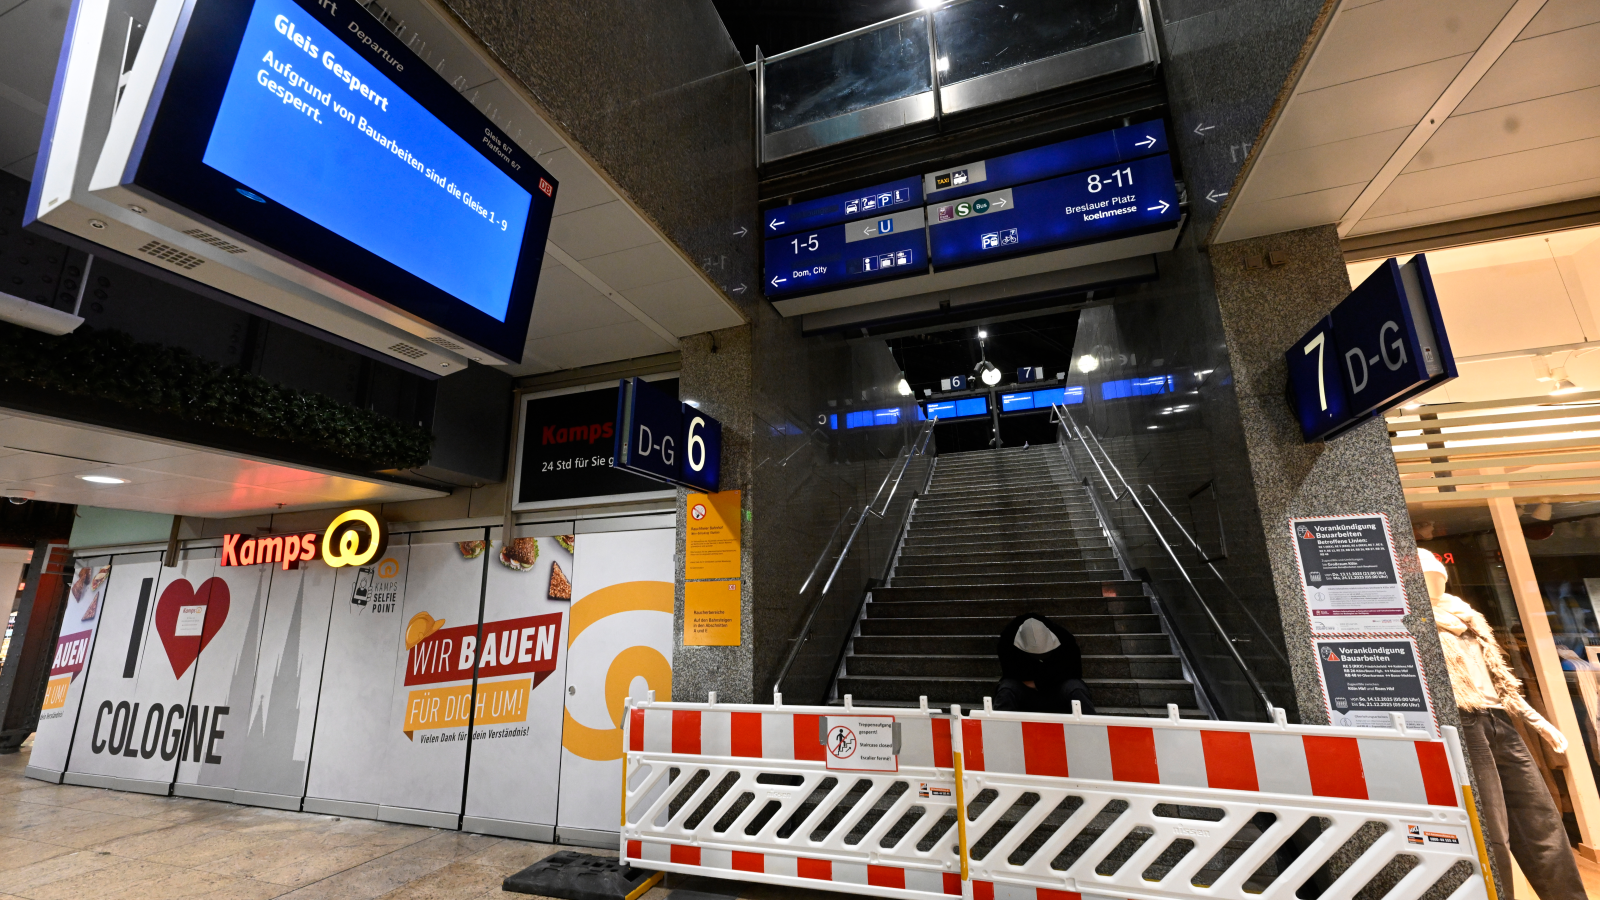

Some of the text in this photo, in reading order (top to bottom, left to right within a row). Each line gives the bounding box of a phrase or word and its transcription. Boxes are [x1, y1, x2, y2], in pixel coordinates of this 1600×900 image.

[348, 21, 404, 72] Departure
[274, 14, 389, 112] Gleis Gesperrt
[257, 69, 323, 124] Gesperrt.
[262, 50, 331, 107] Aufgrund
[333, 100, 355, 124] von
[358, 116, 424, 173] Bauarbeiten
[426, 168, 446, 189] sind
[447, 180, 461, 199] die
[462, 192, 488, 219] Gleise
[489, 211, 495, 223] 1
[501, 220, 508, 232] 9
[484, 128, 512, 154] Gleis 6/7
[482, 136, 521, 171] Platform 6/7
[540, 178, 552, 196] DB
[1087, 167, 1134, 193] 8-11
[1065, 194, 1136, 215] Breslauer Platz
[1083, 204, 1137, 221] koelnmesse
[880, 220, 890, 232] U
[791, 234, 819, 254] 1-5
[793, 266, 827, 278] Dom, City
[1024, 367, 1031, 378] 7
[1304, 320, 1407, 411] 7 D-G
[952, 376, 960, 387] 6
[542, 422, 613, 445] Kamps
[638, 416, 706, 471] D-G 6
[542, 461, 553, 472] 24
[556, 459, 572, 471] Std
[575, 458, 589, 468] für
[591, 456, 605, 467] Sie
[221, 533, 317, 570] Kamps
[374, 593, 396, 602] SELFIE
[375, 582, 398, 592] KAMPS
[372, 604, 395, 613] POINT
[122, 577, 154, 678] I
[52, 638, 89, 669] AUEN
[413, 624, 556, 676] WIR BAUEN
[51, 684, 67, 704] UM!
[410, 689, 524, 724] FÜR DICH UM!
[91, 700, 230, 764] COLOGNE
[420, 726, 529, 744] Vielen Dank für dein Verständnis!
[1173, 823, 1210, 837] nissen
